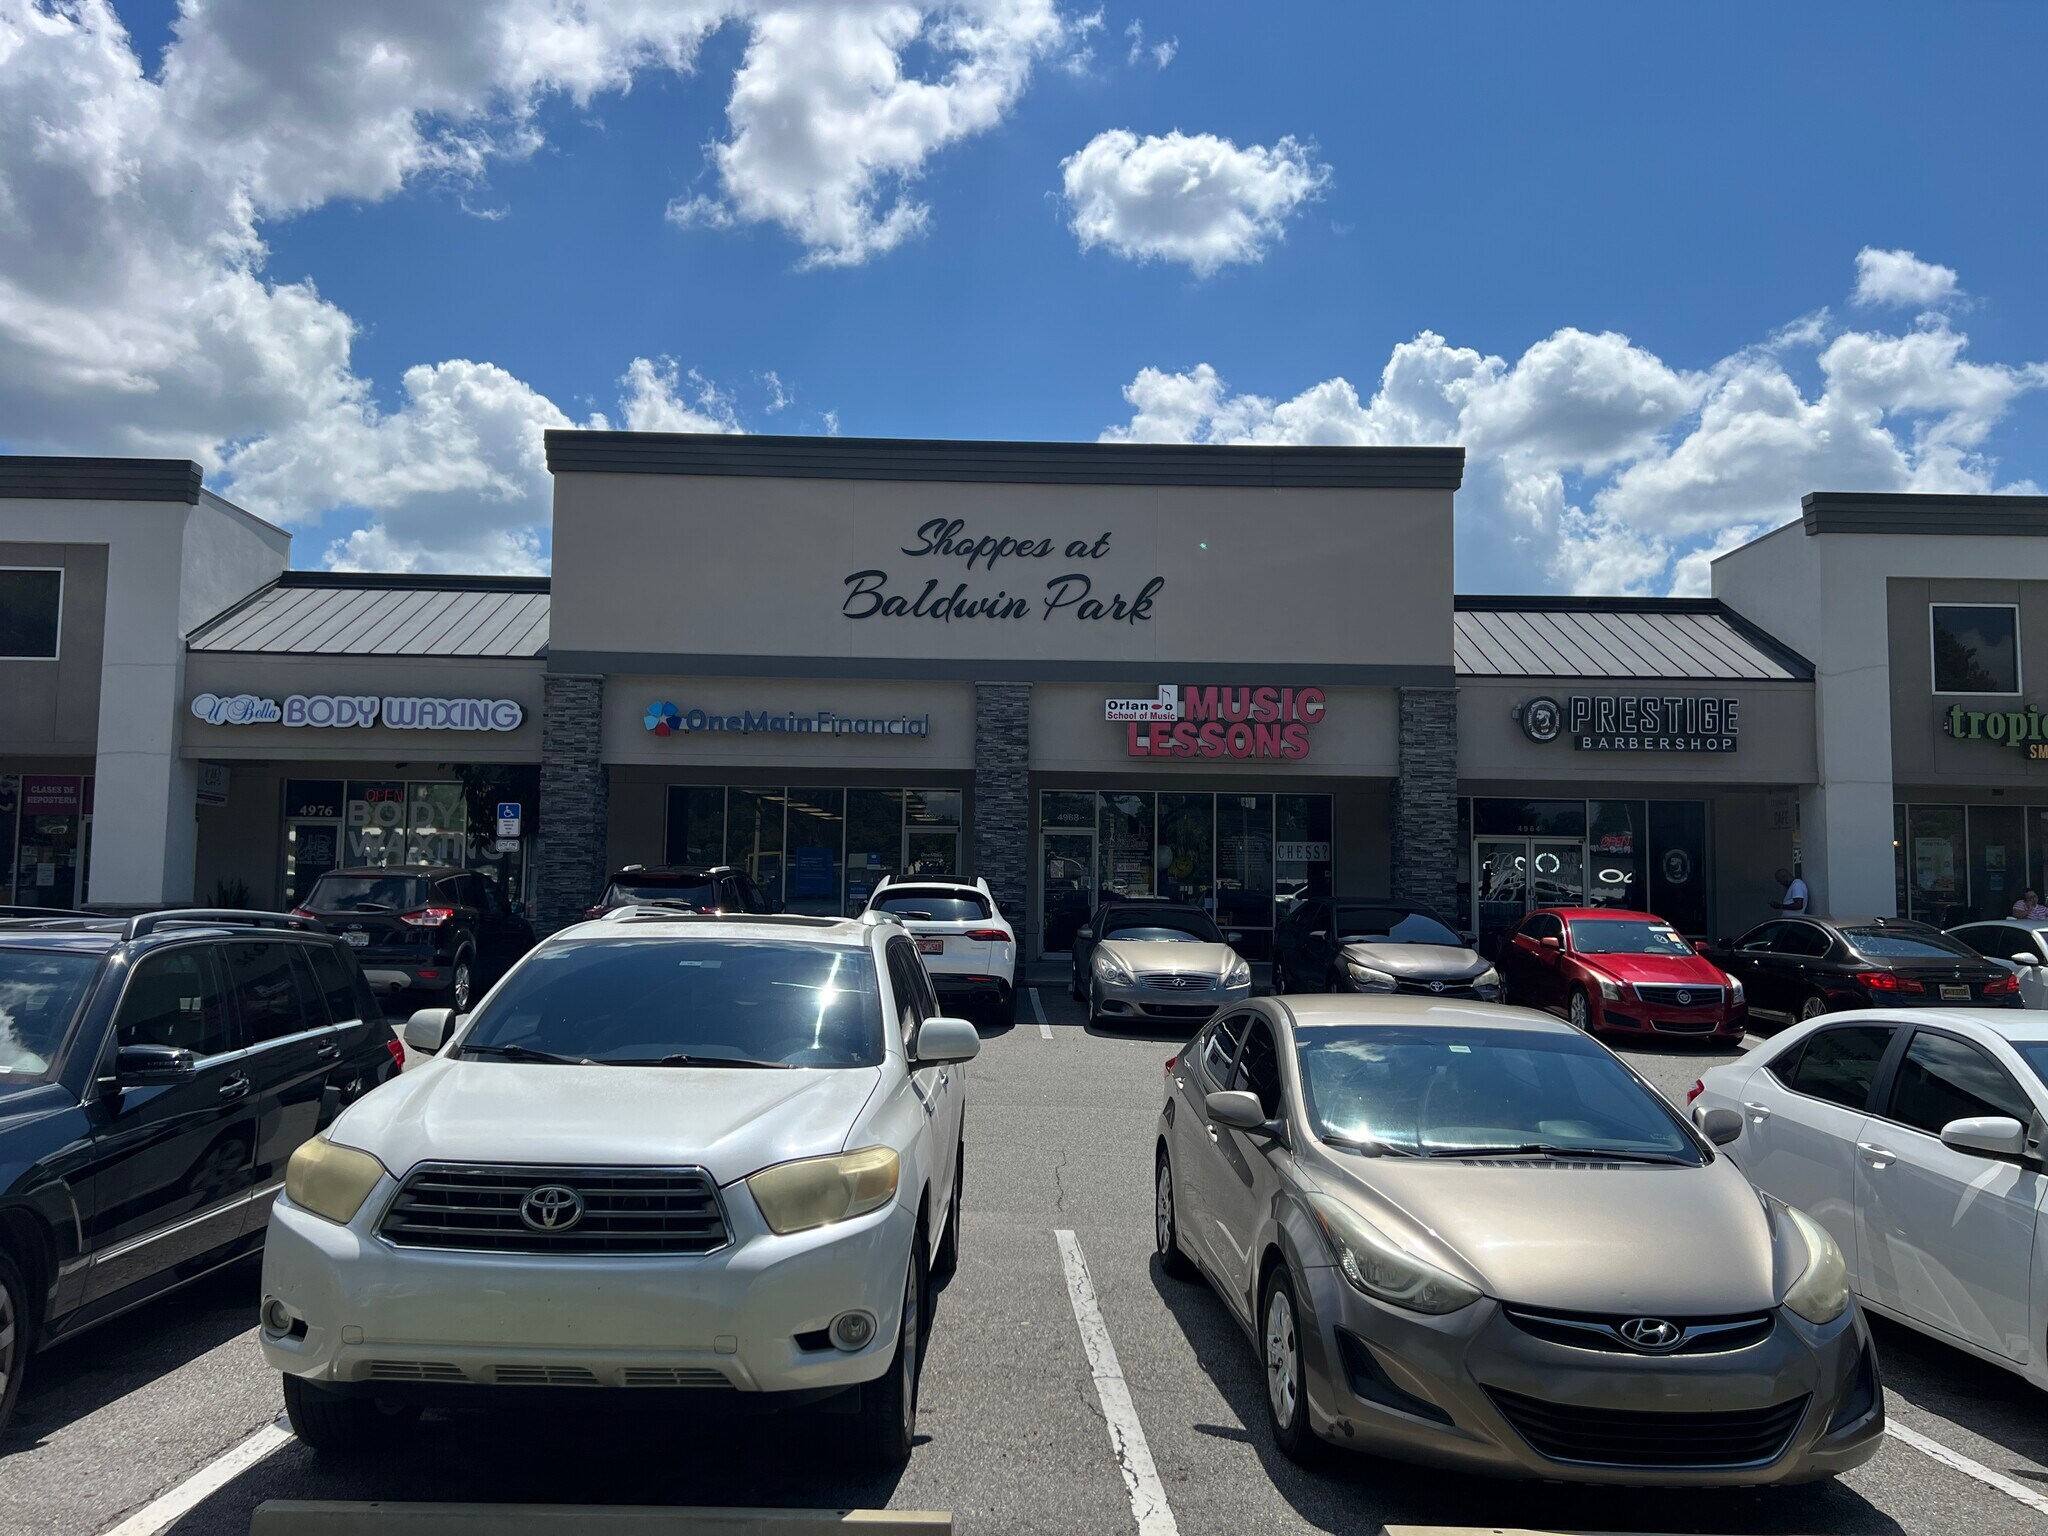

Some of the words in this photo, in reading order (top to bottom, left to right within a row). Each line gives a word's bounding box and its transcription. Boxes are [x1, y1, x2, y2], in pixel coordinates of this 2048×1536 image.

[901, 518, 1055, 570] Shoppes
[1065, 532, 1112, 558] at
[843, 570, 1031, 623] Baldwin
[1043, 574, 1165, 625] Park
[227, 700, 277, 721] Bella
[287, 699, 376, 724] BODY
[386, 701, 518, 728] WAXING
[1184, 686, 1326, 723] MUSIC
[1107, 711, 1137, 720] School
[1139, 711, 1148, 720] of
[1150, 711, 1176, 720] Music
[1569, 696, 1739, 735] PRESTIGE
[1128, 721, 1310, 759] LESSONS
[1582, 736, 1733, 750] BARBERSHOP
[31, 786, 61, 794] CLASES
[63, 786, 75, 794] DE
[366, 789, 404, 801] OPEN
[299, 805, 333, 817] 4976
[348, 800, 461, 828] BODY
[1057, 813, 1079, 822] 4968
[1277, 844, 1328, 859] CHESS?
